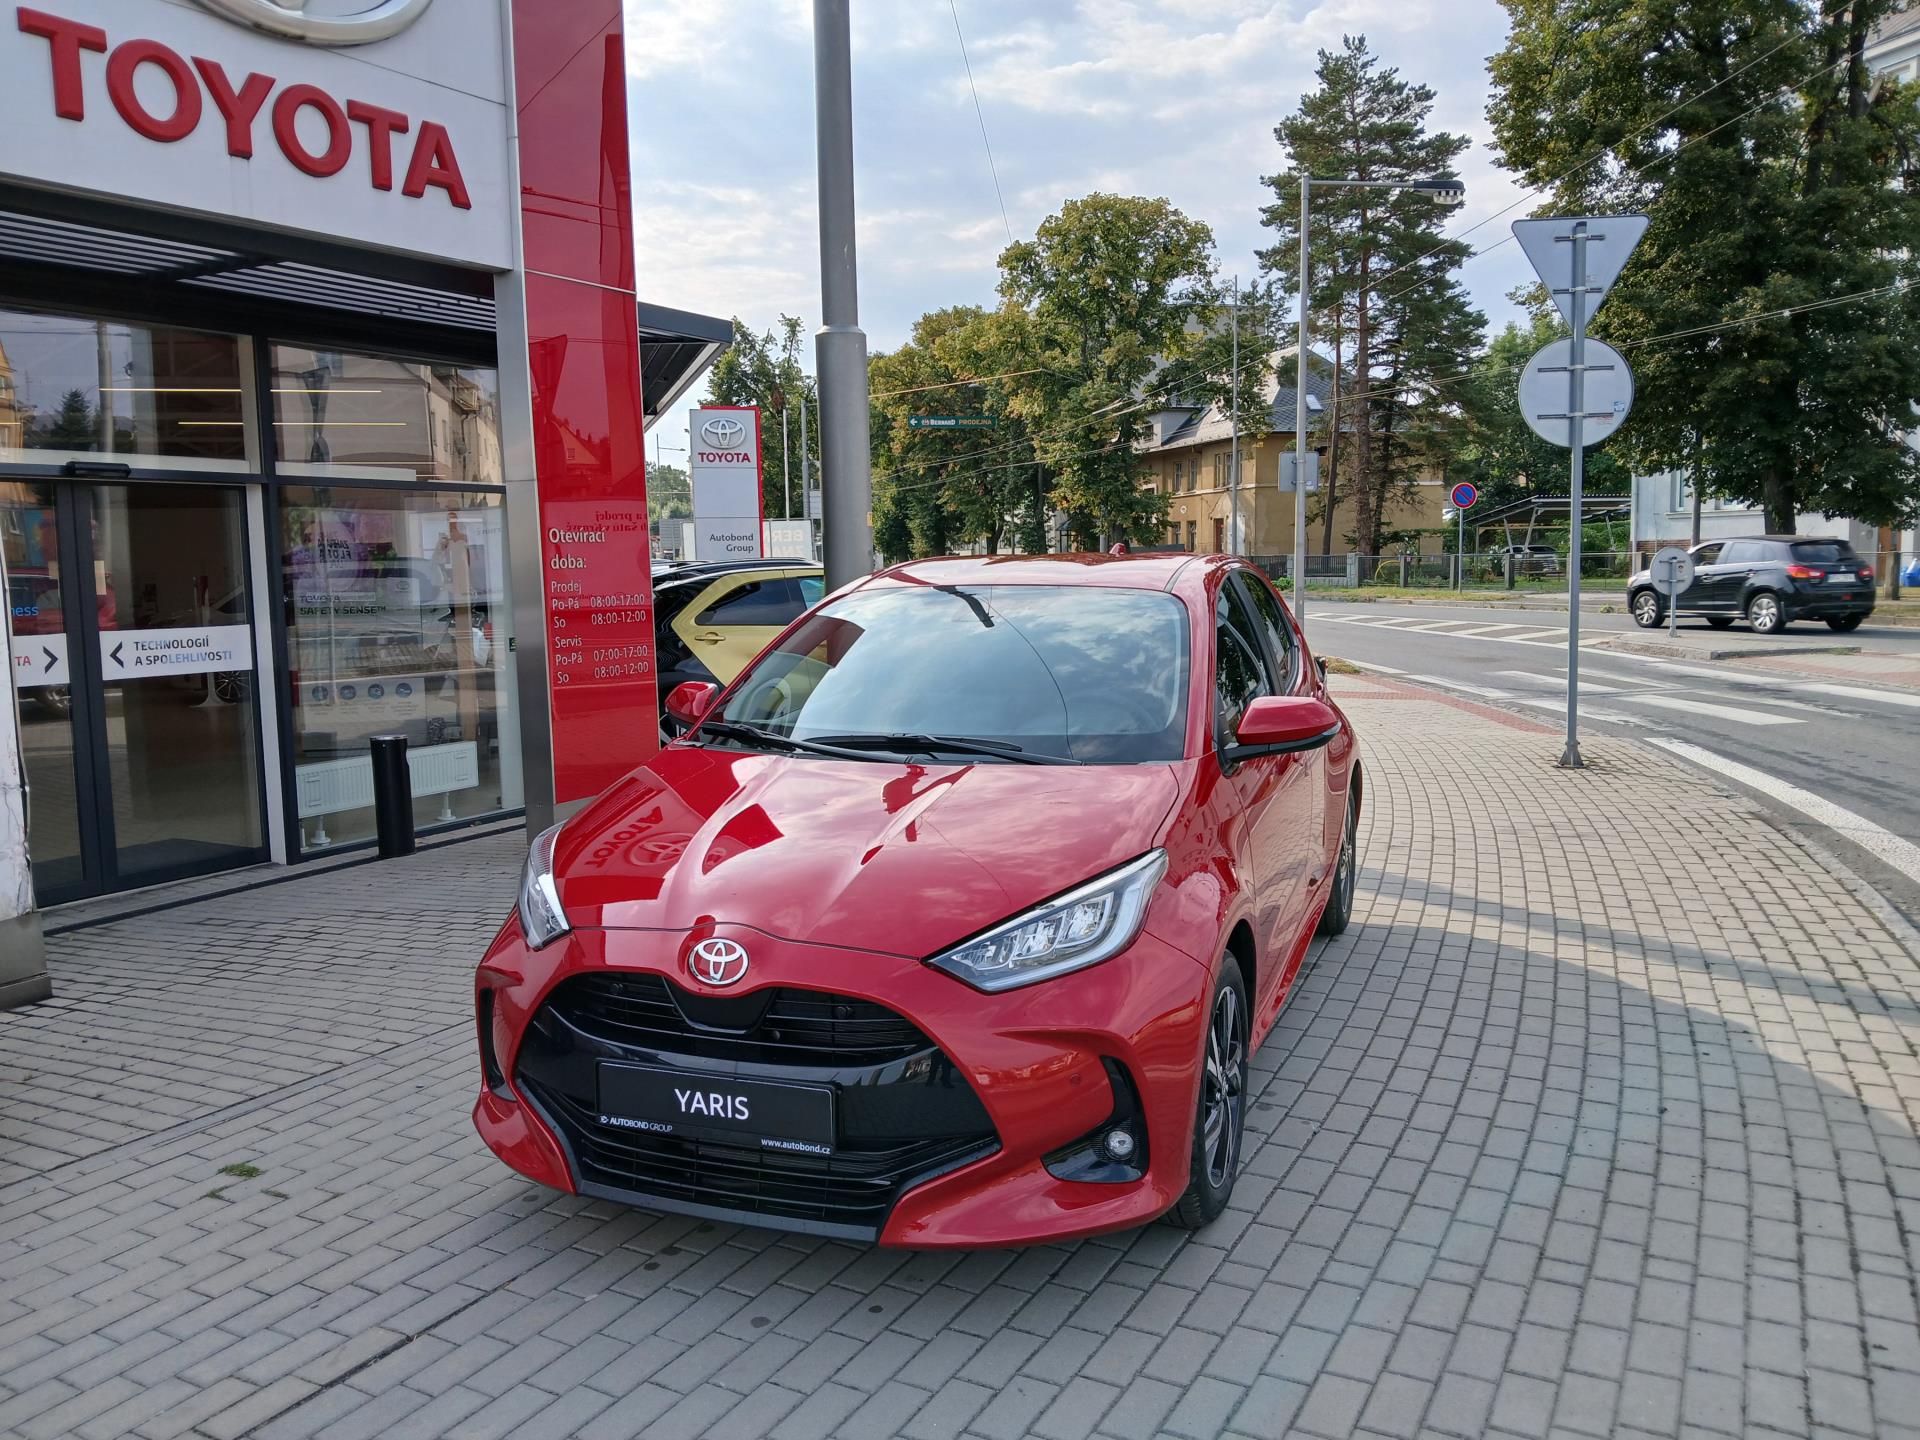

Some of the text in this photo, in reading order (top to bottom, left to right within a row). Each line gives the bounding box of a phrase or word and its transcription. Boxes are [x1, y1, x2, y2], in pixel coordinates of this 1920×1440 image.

[16, 6, 472, 210] TOYOTA
[698, 452, 751, 464] TOYOTA
[549, 528, 606, 543] Otevírací
[710, 534, 754, 542] Autobond
[726, 544, 754, 553] Group
[551, 554, 586, 569] doba:
[551, 581, 582, 594] Prodej
[552, 598, 580, 610] Po-Pá
[590, 594, 645, 608] 08:00-17:00
[300, 606, 340, 615] SAFETY
[554, 610, 646, 628] So 08:00-12:00
[134, 635, 210, 652] TECHNOLOGIÍ
[555, 636, 582, 648] Servis
[16, 656, 32, 667] TA
[135, 650, 232, 666] A SPOLEHLIVOSTI
[556, 645, 648, 666] Po-Pá 07:00-17:00
[557, 662, 649, 684] So 08:00-12:00
[674, 1088, 750, 1120] YARIS
[610, 1117, 674, 1134] AUTOBOND GROUP
[761, 1138, 831, 1155] www.autobond.cz
